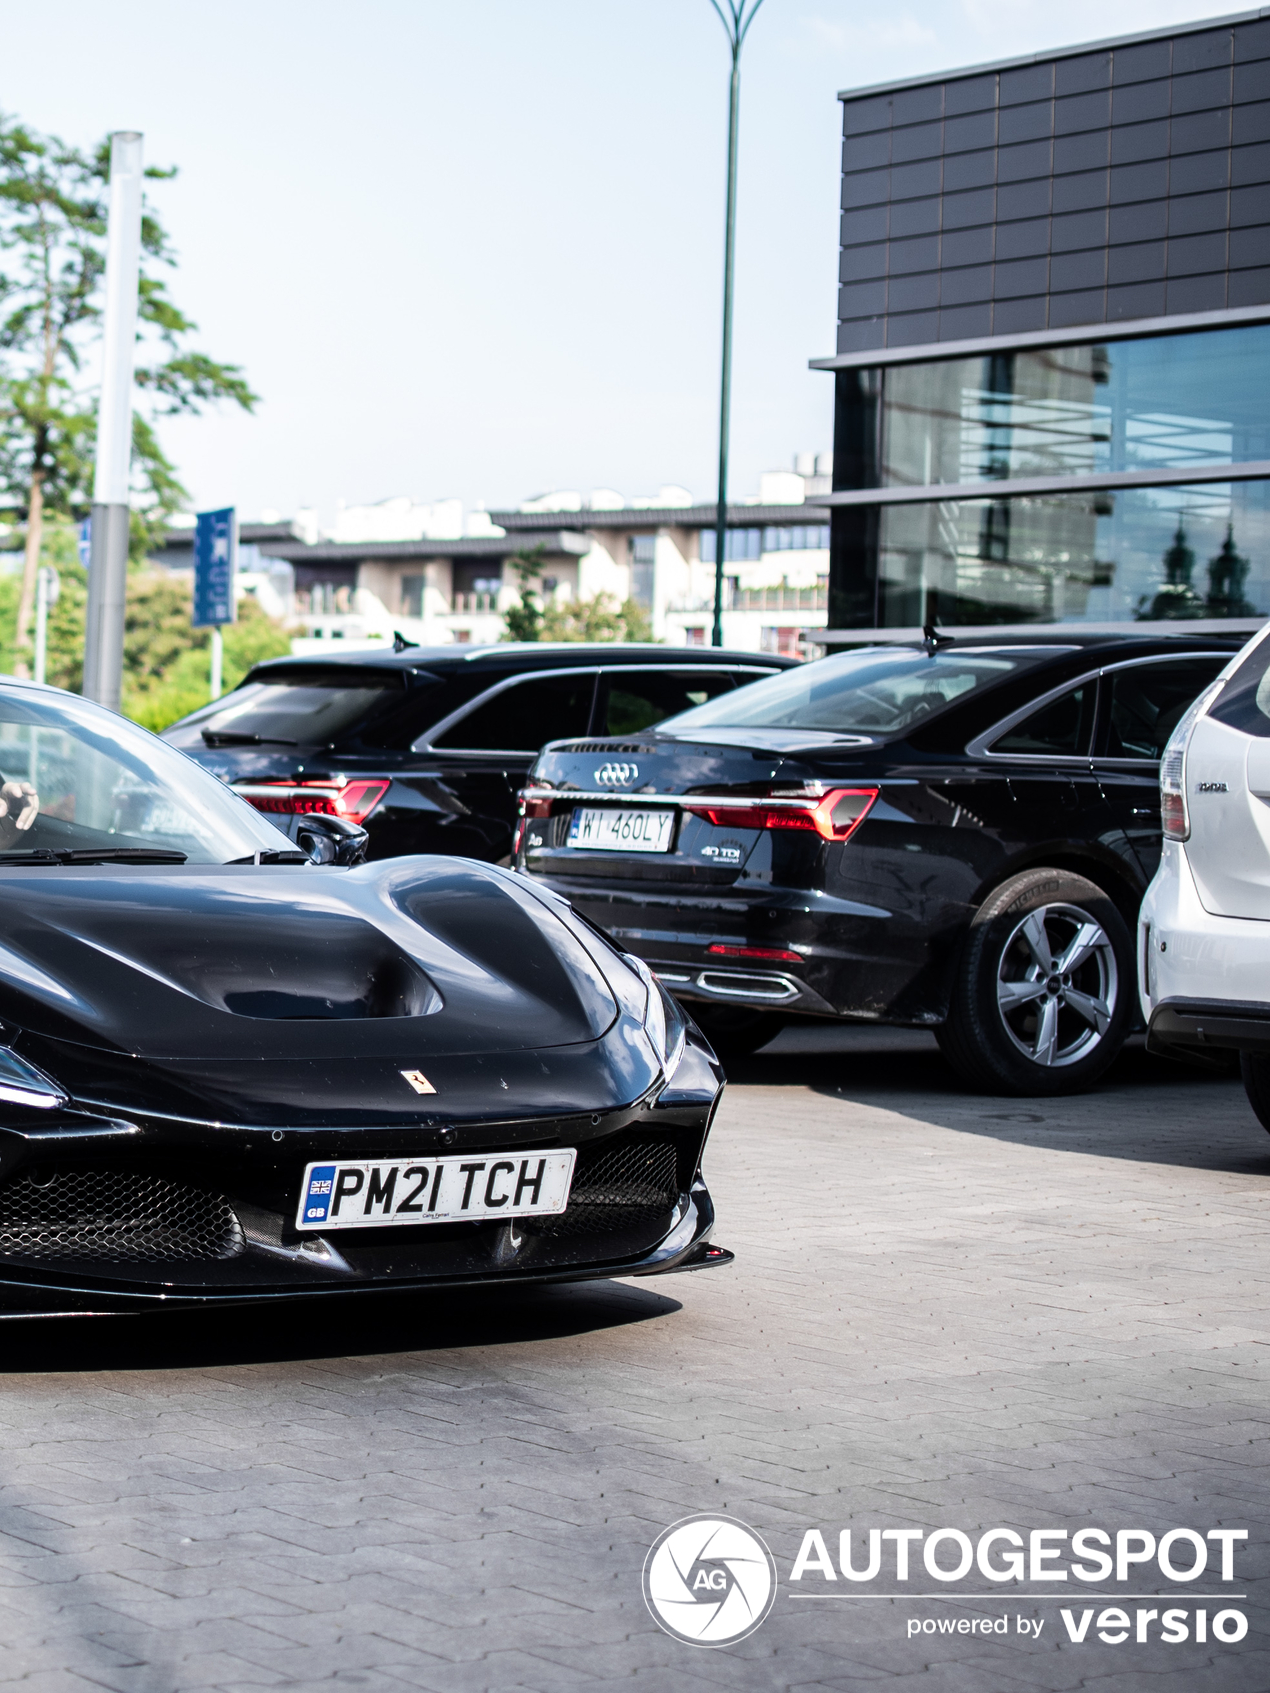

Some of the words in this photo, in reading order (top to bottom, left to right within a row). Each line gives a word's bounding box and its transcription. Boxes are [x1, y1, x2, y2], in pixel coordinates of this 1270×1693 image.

[583, 812, 603, 839] WI
[611, 813, 669, 842] 460LY
[701, 845, 719, 856] 40
[720, 847, 740, 858] TDI
[330, 1164, 445, 1217] PM21
[459, 1158, 547, 1211] TCH
[307, 1207, 325, 1218] GB
